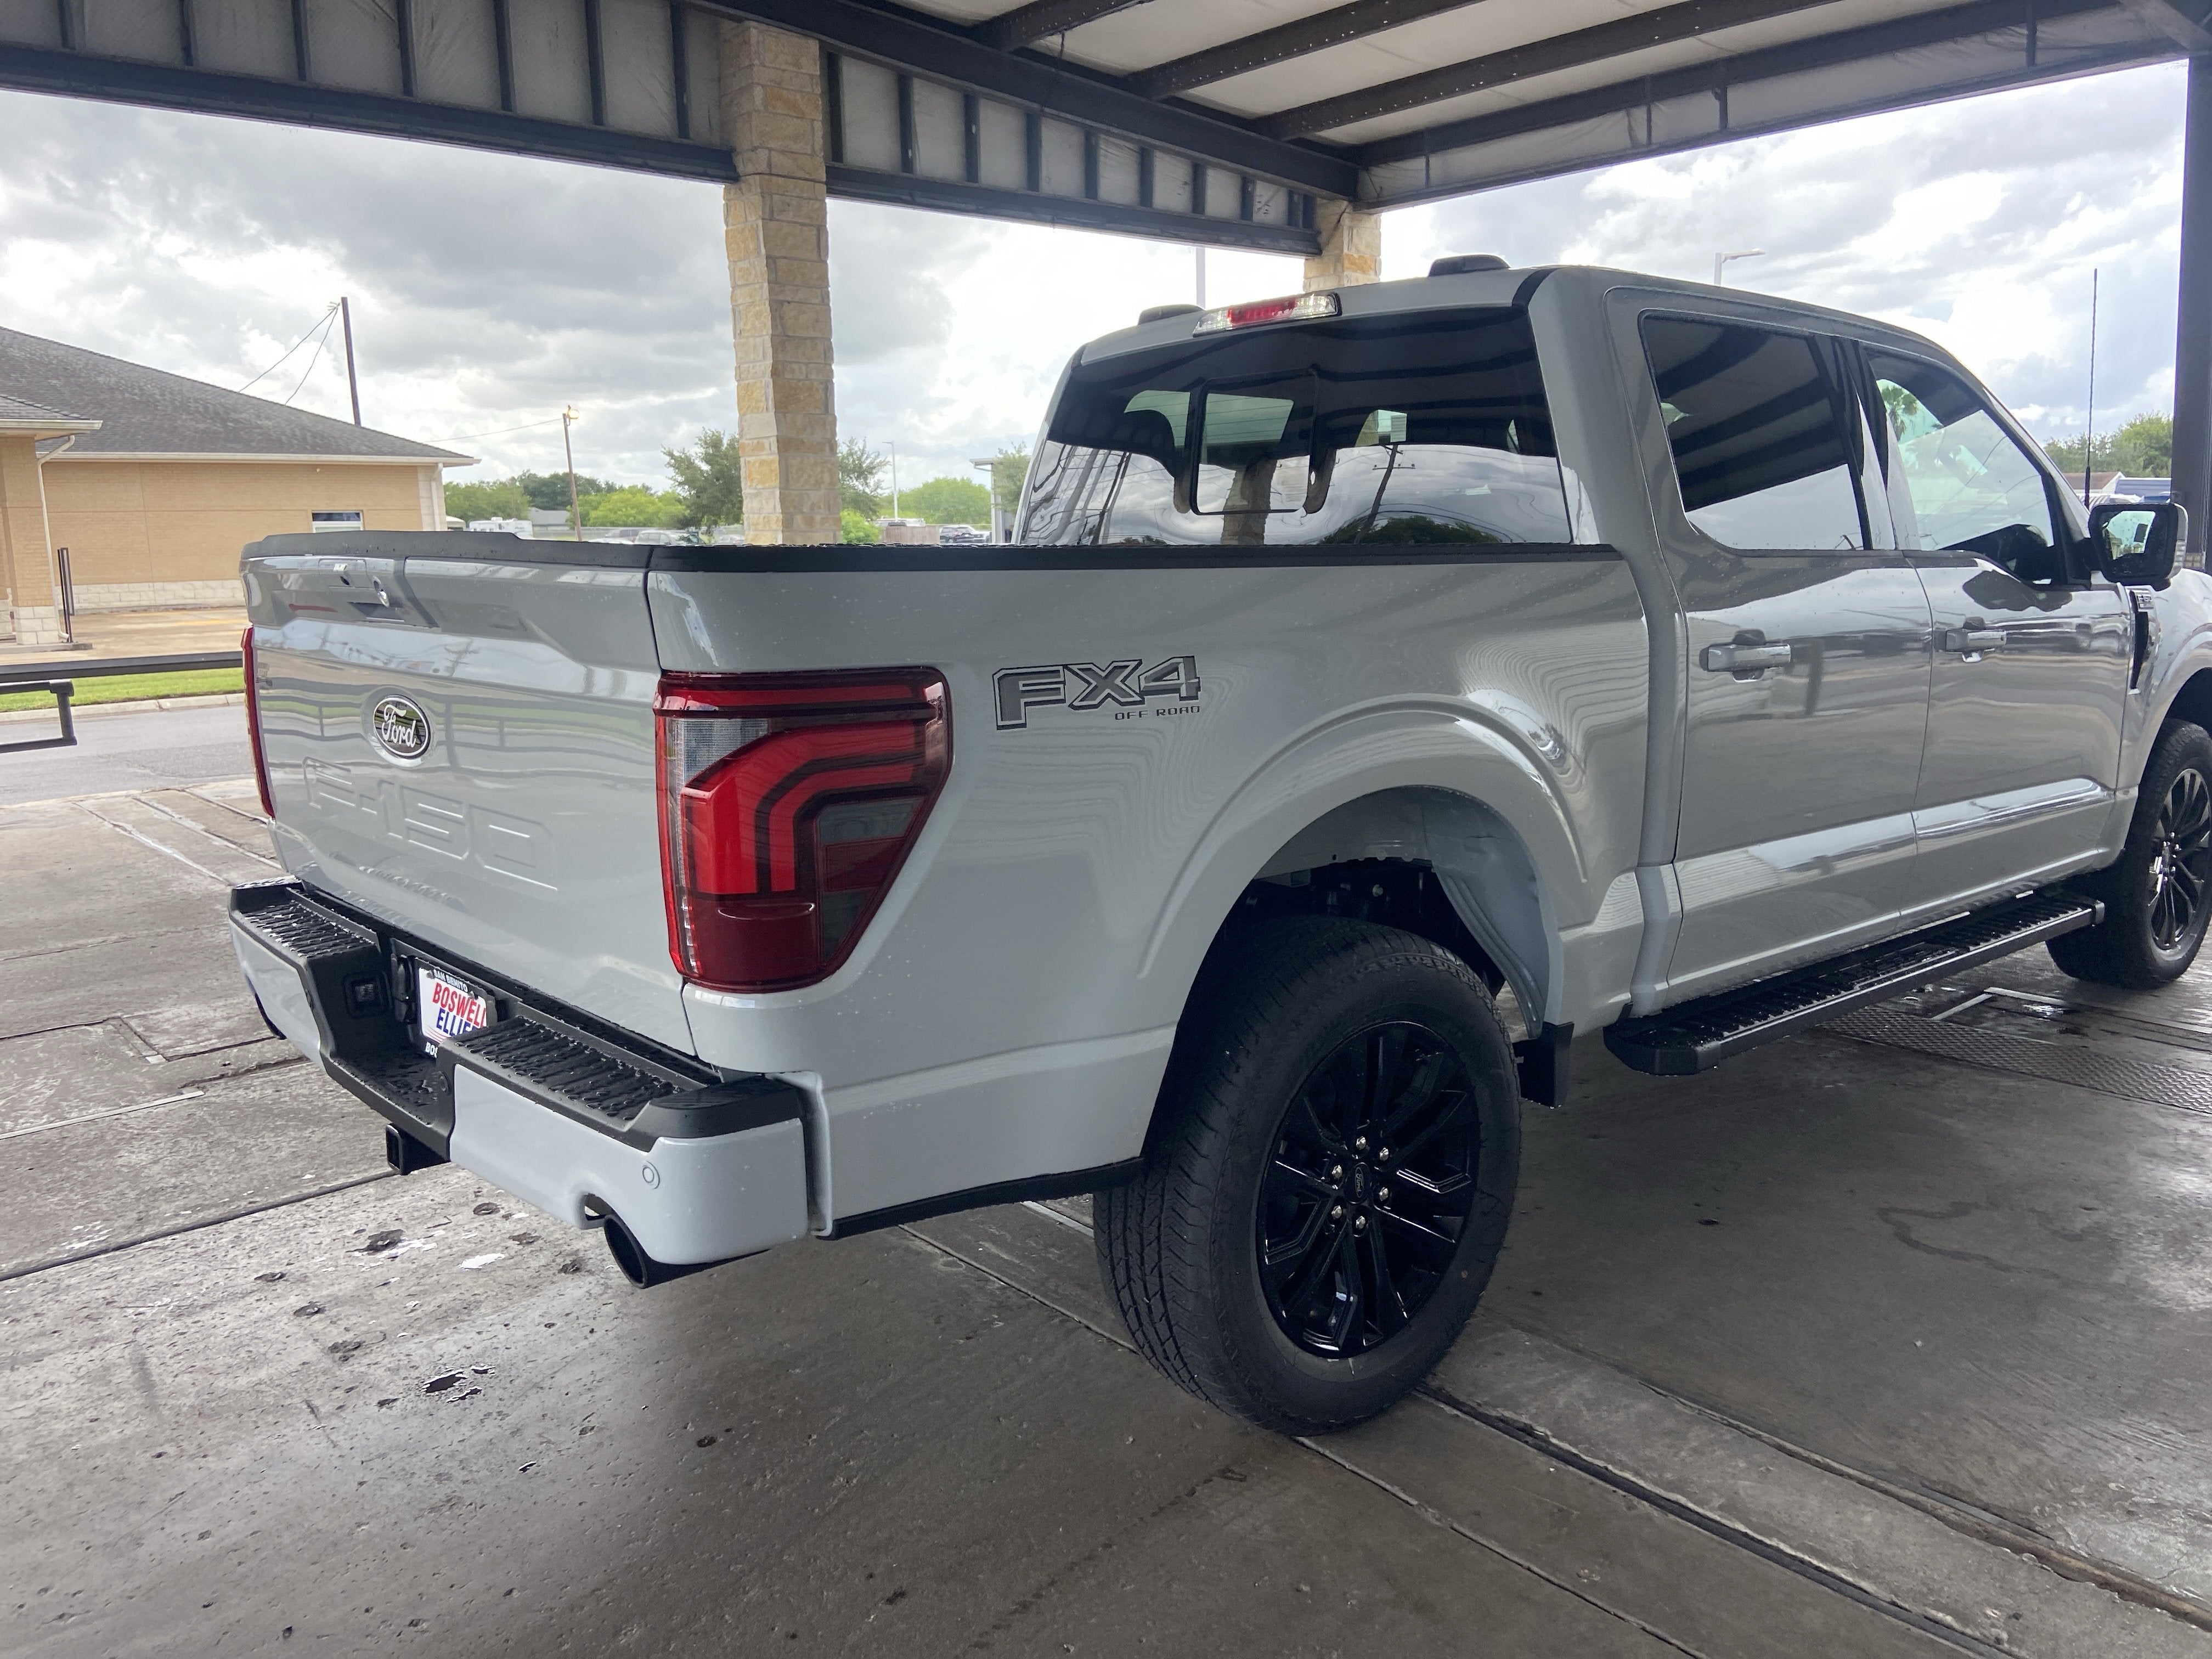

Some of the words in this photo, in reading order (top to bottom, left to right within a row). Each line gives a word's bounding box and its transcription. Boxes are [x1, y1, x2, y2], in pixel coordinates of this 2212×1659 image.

[992, 656, 1201, 731] FX4
[381, 704, 416, 748] Ford
[1115, 710, 1148, 720] OFF
[1156, 706, 1200, 716] ROAD
[433, 969, 445, 982] SAN
[447, 975, 469, 993] BENITO
[436, 1007, 479, 1036] ELLIF
